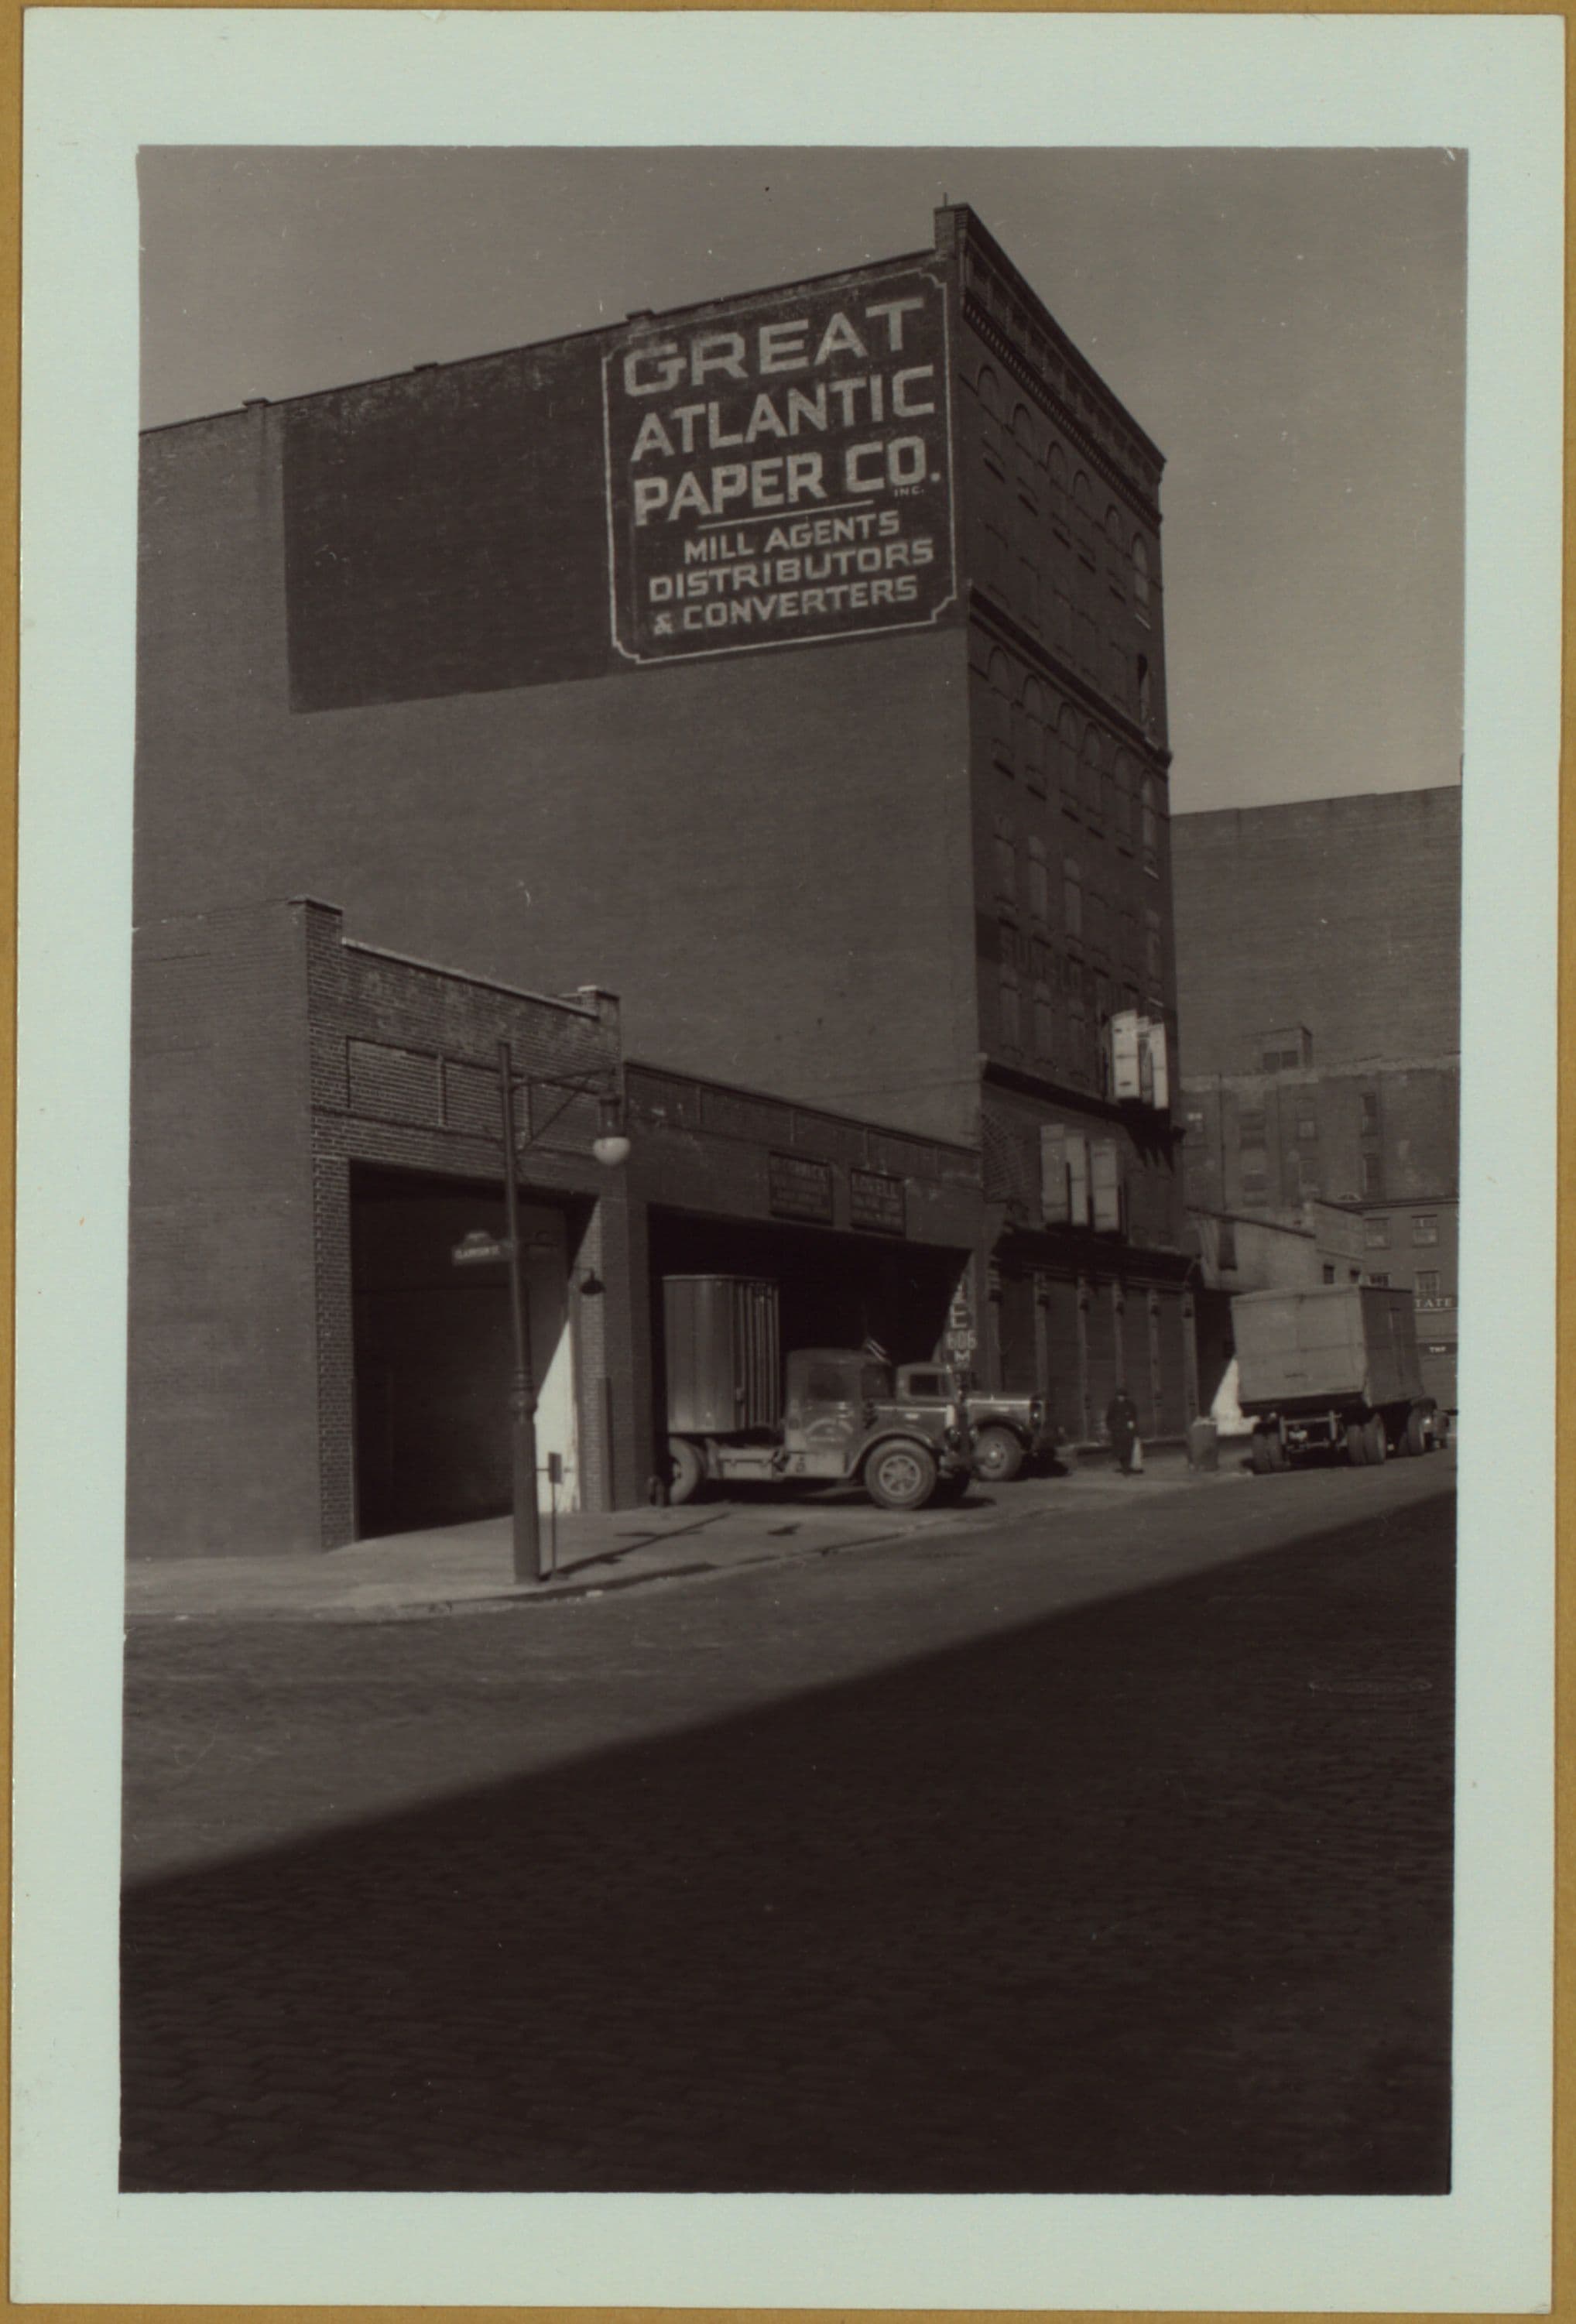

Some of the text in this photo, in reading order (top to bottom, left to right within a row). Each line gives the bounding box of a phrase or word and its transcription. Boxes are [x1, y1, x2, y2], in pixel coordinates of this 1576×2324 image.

[623, 298, 924, 397] GREAT
[630, 365, 935, 461] ATLANTIC
[634, 436, 940, 526] PAPER CO.
[894, 486, 924, 497] INC.
[684, 510, 899, 565] MILL AGENTS
[649, 540, 934, 602] DISTRIBUTORS
[653, 575, 918, 635] & CONVERTERS
[1415, 1298, 1451, 1307] TATE
